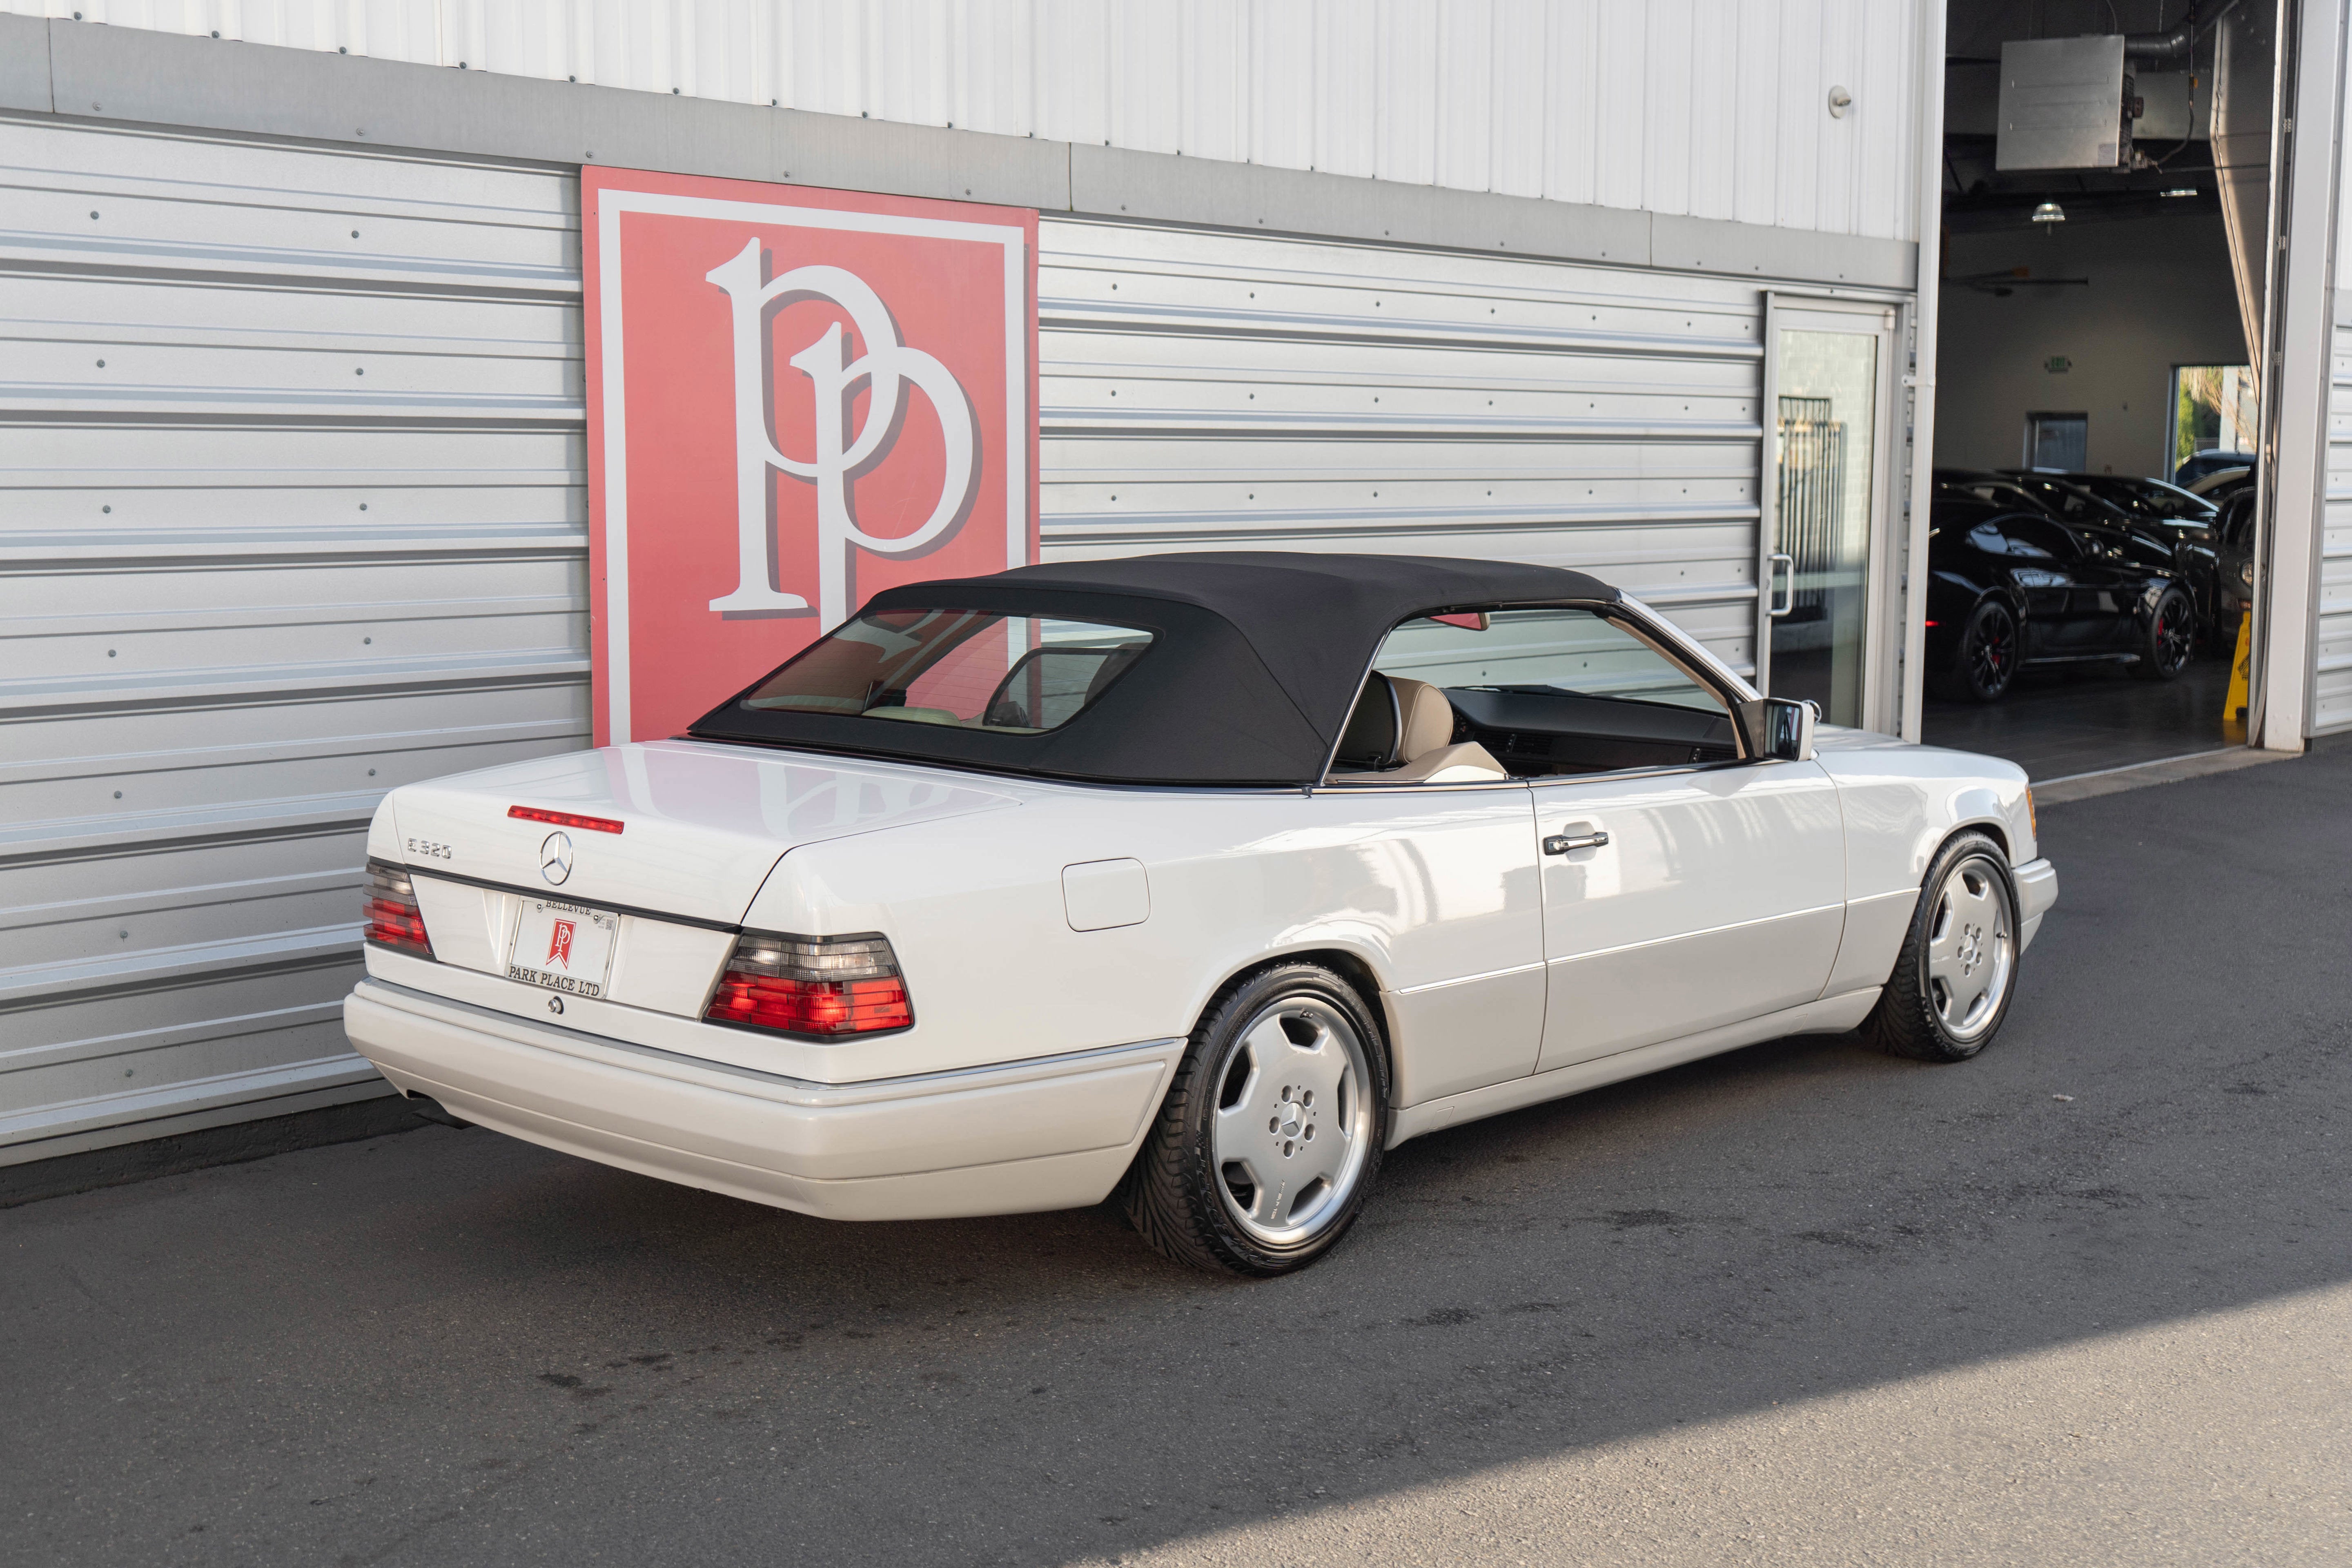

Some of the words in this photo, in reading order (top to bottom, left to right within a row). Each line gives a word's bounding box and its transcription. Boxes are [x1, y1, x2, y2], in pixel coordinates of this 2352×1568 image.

[546, 900, 591, 915] BELLEVUE
[508, 966, 537, 983] PARK
[540, 973, 575, 991] PLACE
[578, 981, 600, 996] LTD
